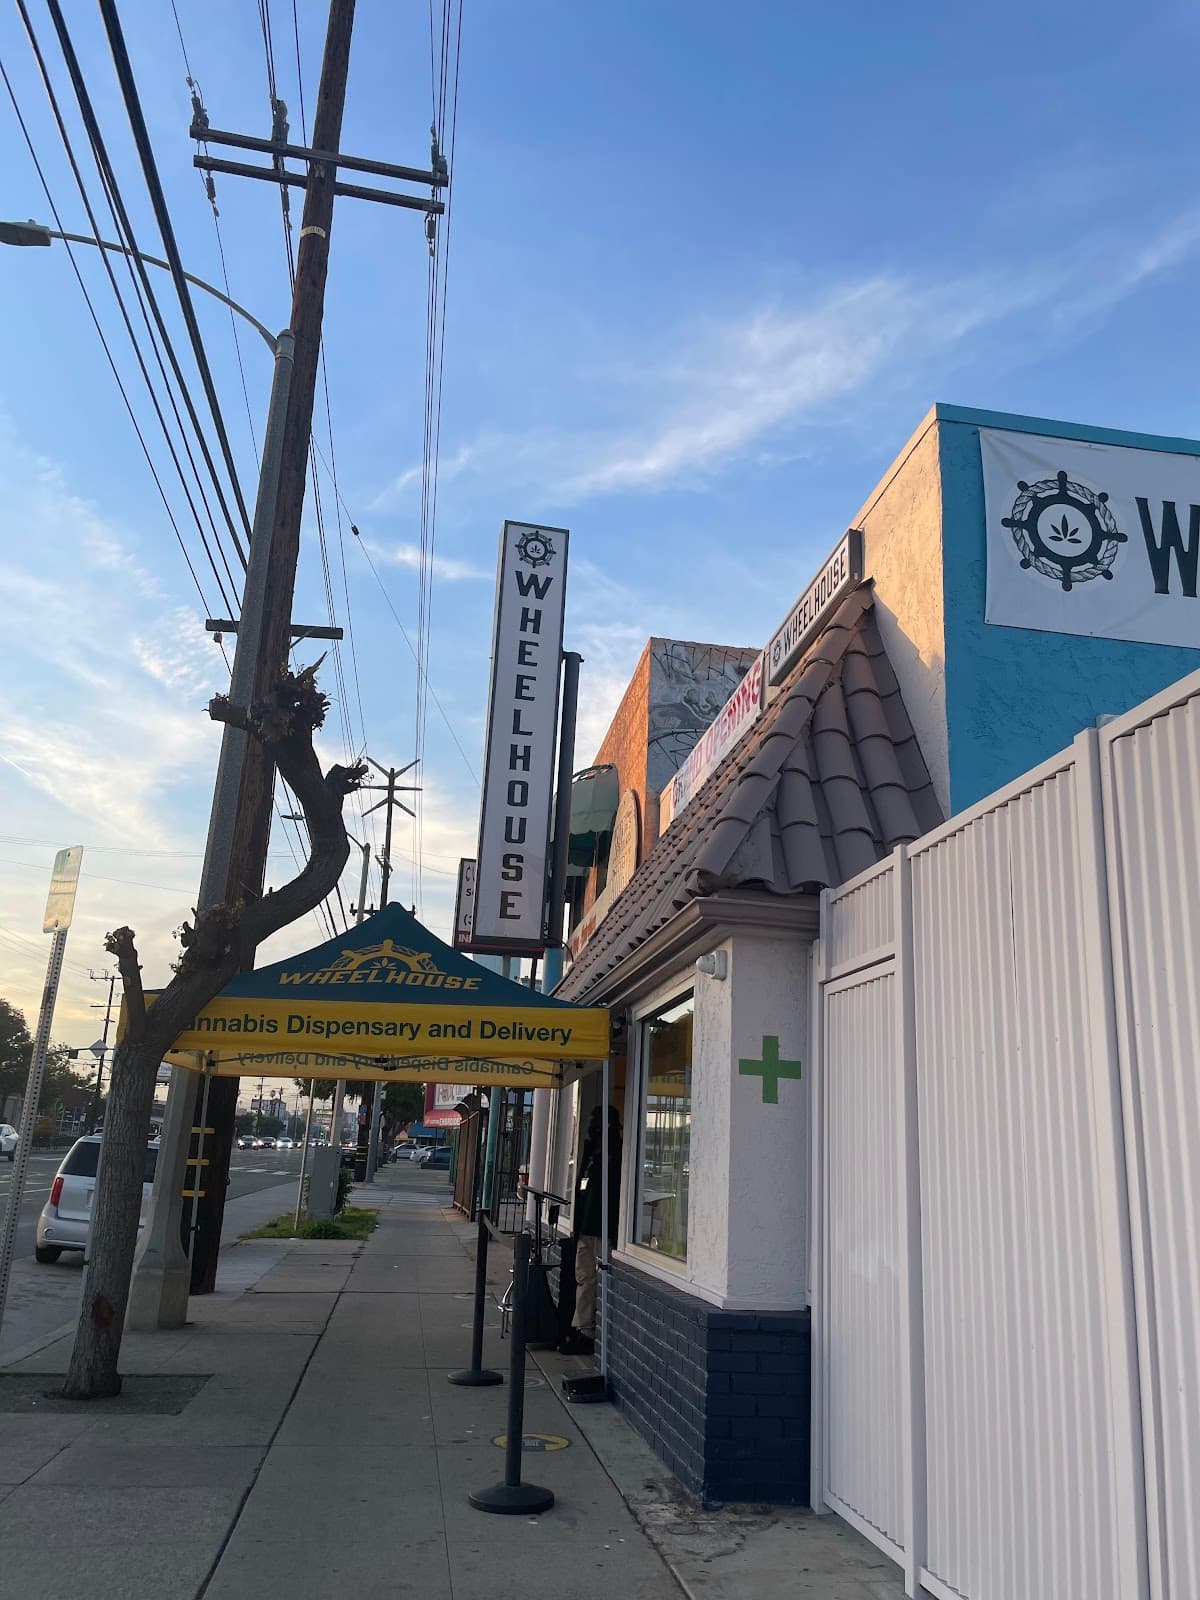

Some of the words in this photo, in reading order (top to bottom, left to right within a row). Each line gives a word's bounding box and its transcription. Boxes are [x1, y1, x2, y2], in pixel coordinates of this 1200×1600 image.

[783, 546, 847, 657] WHEELHOUSE
[498, 570, 554, 920] WHEELHOUSE
[705, 660, 761, 763] OPENING
[183, 1013, 279, 1035] annabis
[286, 1014, 421, 1041] Dispensary
[427, 1021, 471, 1040] and
[479, 1020, 573, 1046] Delivery
[278, 969, 483, 991] WHEELHOUSE
